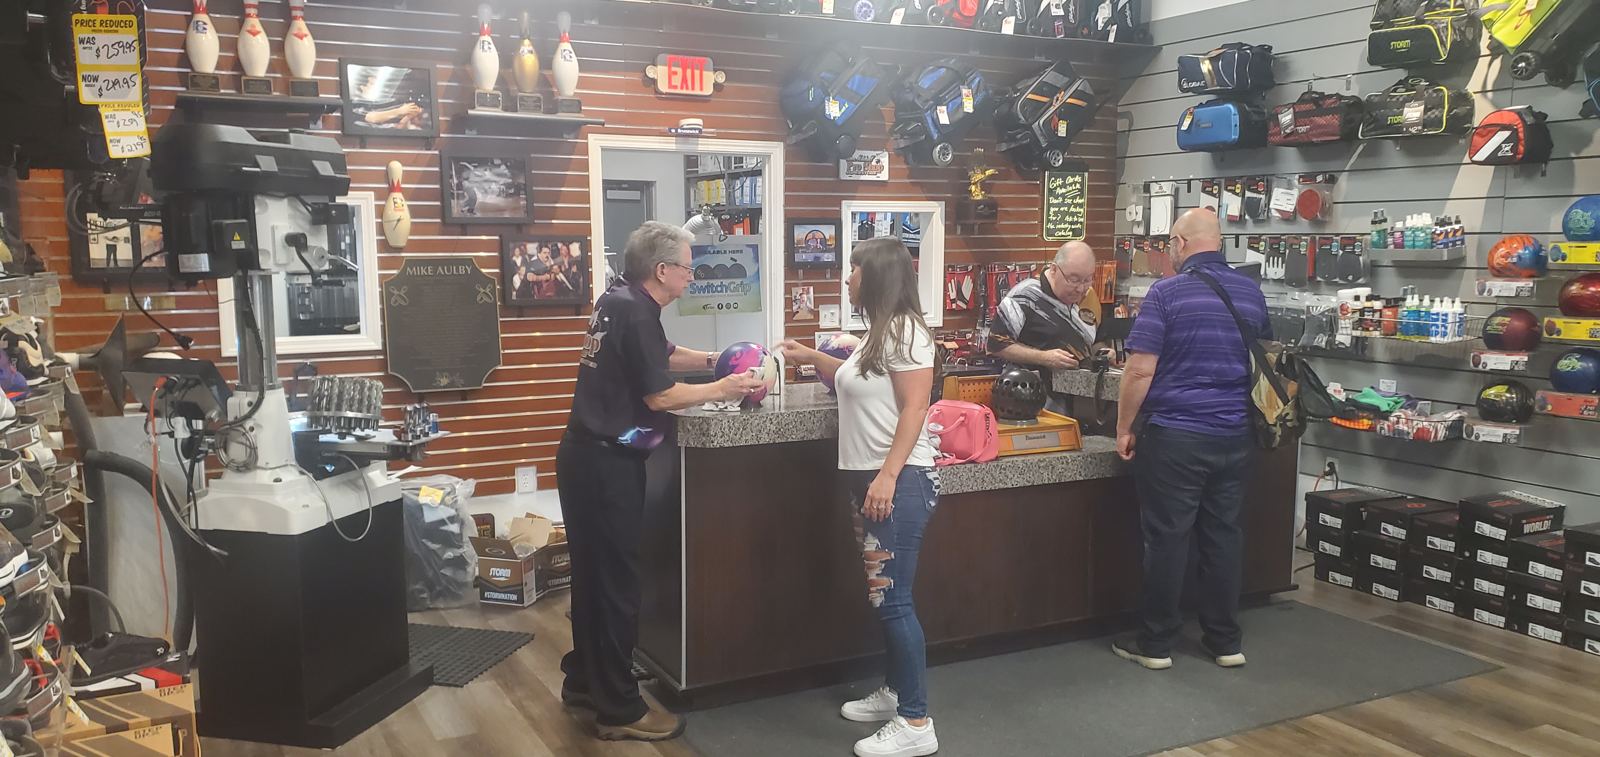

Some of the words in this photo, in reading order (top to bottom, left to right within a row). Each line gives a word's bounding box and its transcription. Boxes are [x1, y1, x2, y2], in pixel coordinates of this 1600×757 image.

[75, 19, 96, 28] PRICE
[100, 20, 133, 28] REDUCED
[79, 36, 96, 45] WAS
[81, 74, 99, 82] NOW
[667, 54, 708, 91] EXIT
[1049, 177, 1064, 189] Gift
[406, 265, 434, 276] MIKE
[436, 264, 473, 276] AULBY
[689, 281, 752, 297] SwitchGrip
[1523, 519, 1552, 534] WORLD!
[489, 568, 511, 577] STORM
